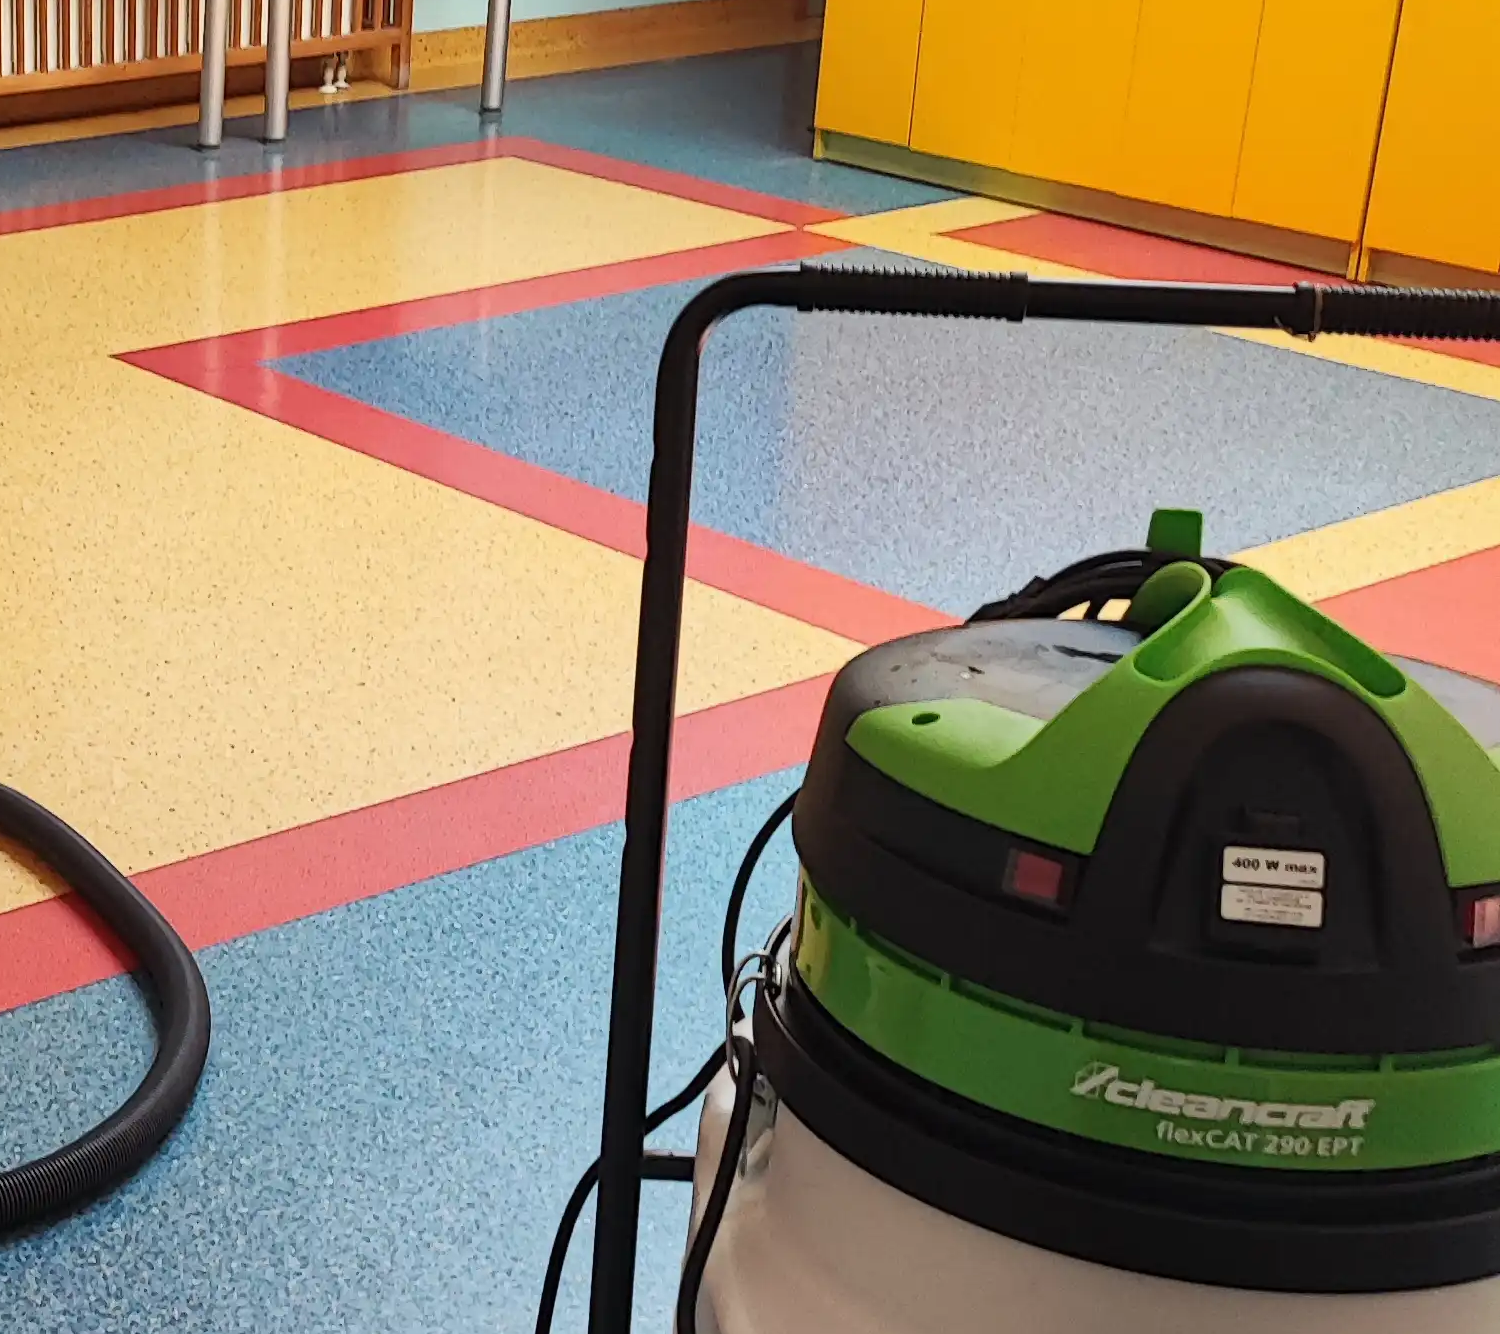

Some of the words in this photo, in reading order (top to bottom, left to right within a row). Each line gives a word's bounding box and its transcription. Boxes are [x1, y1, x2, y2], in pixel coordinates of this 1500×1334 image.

[1232, 857, 1260, 871] 400
[1265, 860, 1279, 872] W
[1285, 863, 1317, 874] max
[1104, 1079, 1376, 1129] cleancraft
[1156, 1120, 1258, 1153] flexCAT
[1263, 1135, 1313, 1156] 290
[1317, 1136, 1364, 1157] EPT
